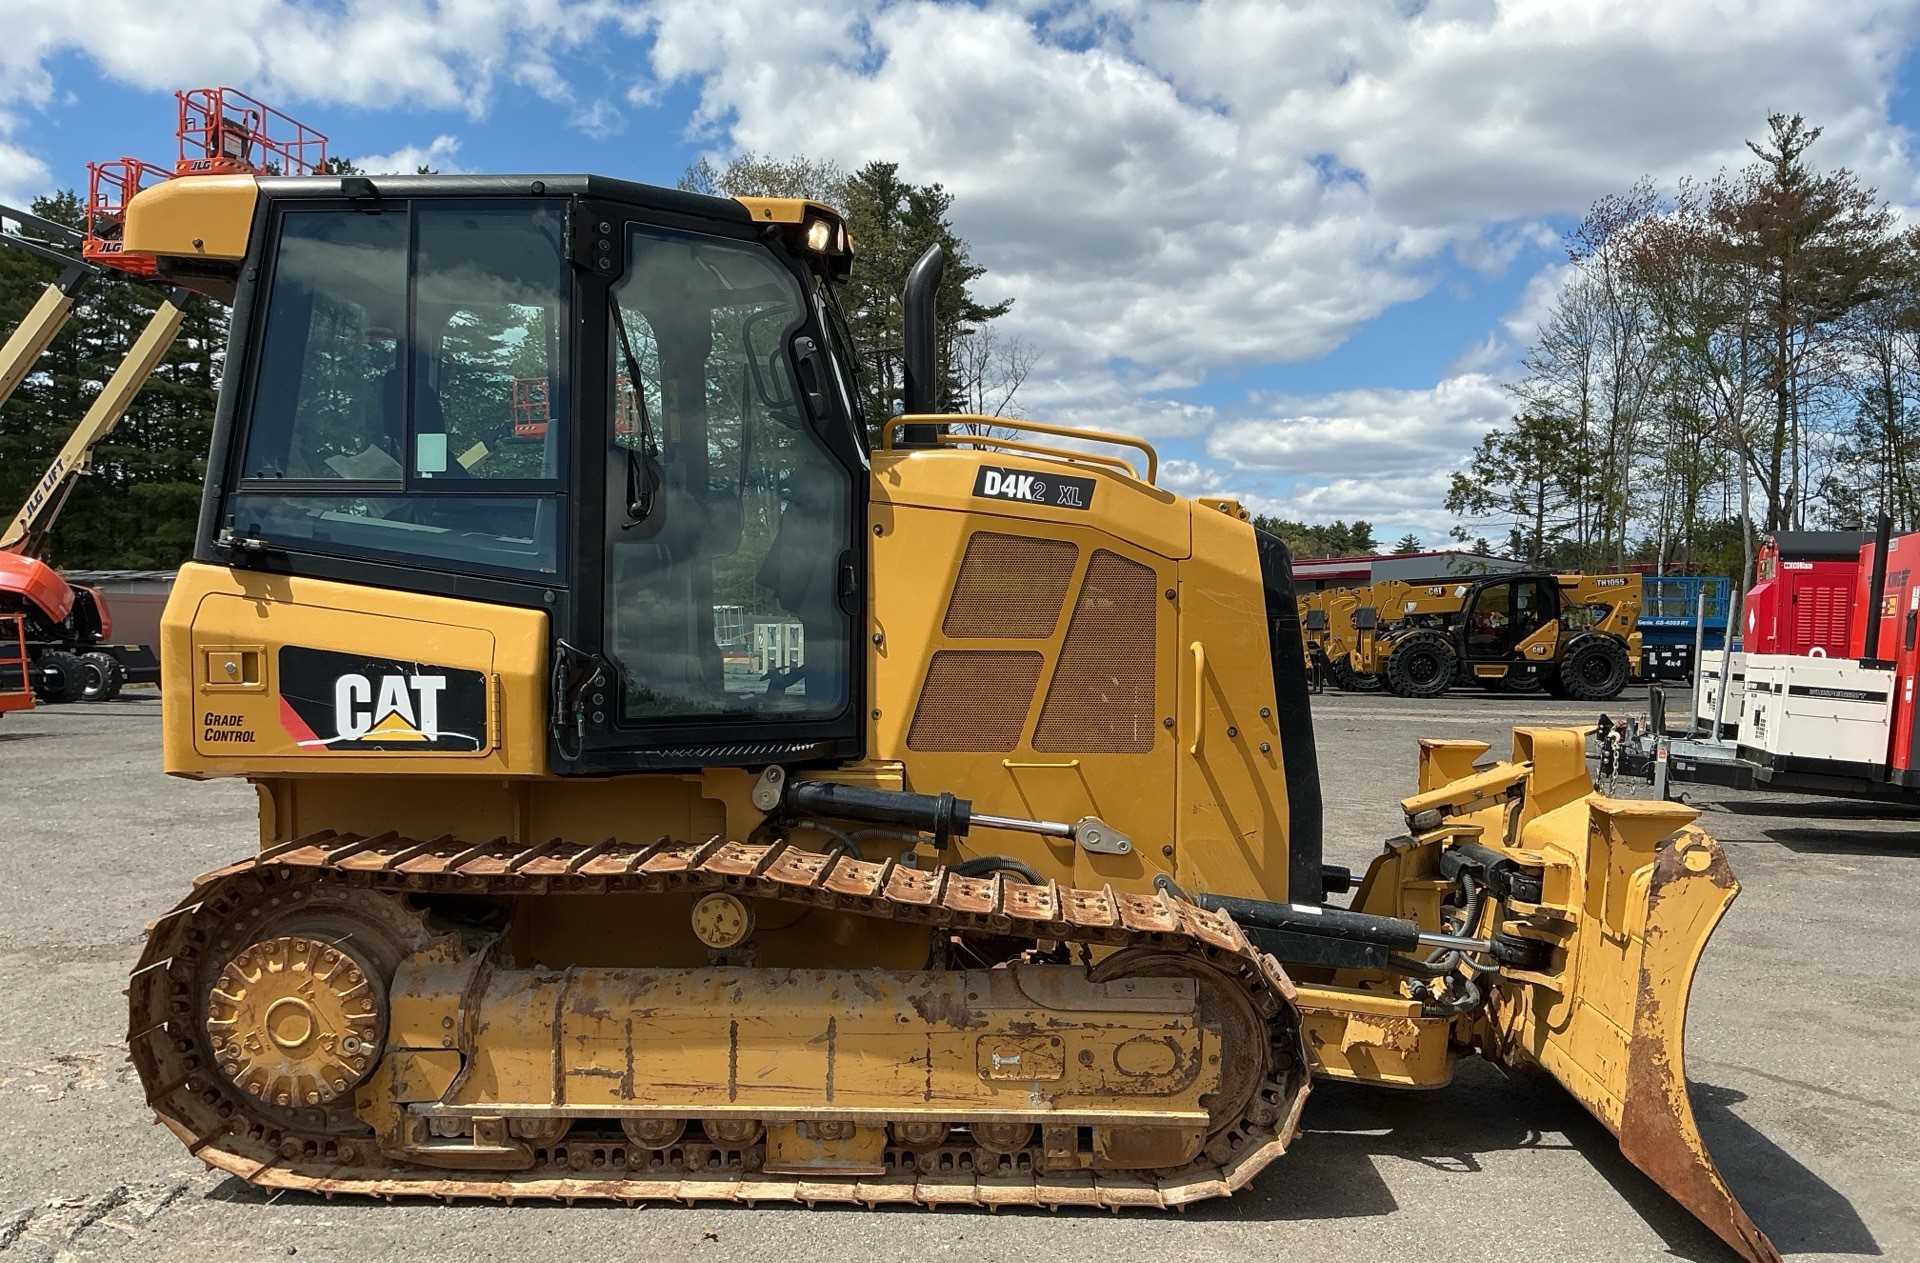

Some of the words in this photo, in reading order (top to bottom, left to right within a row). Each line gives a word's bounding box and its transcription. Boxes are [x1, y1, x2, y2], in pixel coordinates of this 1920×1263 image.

[191, 160, 211, 171] JLG
[99, 242, 122, 253] JLG
[26, 489, 44, 520] JLG
[42, 457, 65, 493] LIFT
[1057, 484, 1083, 507] XL
[1596, 578, 1625, 587] TH1055
[1428, 586, 1443, 596] CAT
[1532, 647, 1545, 655] CAT
[1665, 659, 1682, 667] 4x4
[335, 673, 447, 742] CAT
[204, 712, 244, 727] GRADE
[204, 728, 256, 743] CONTROL
